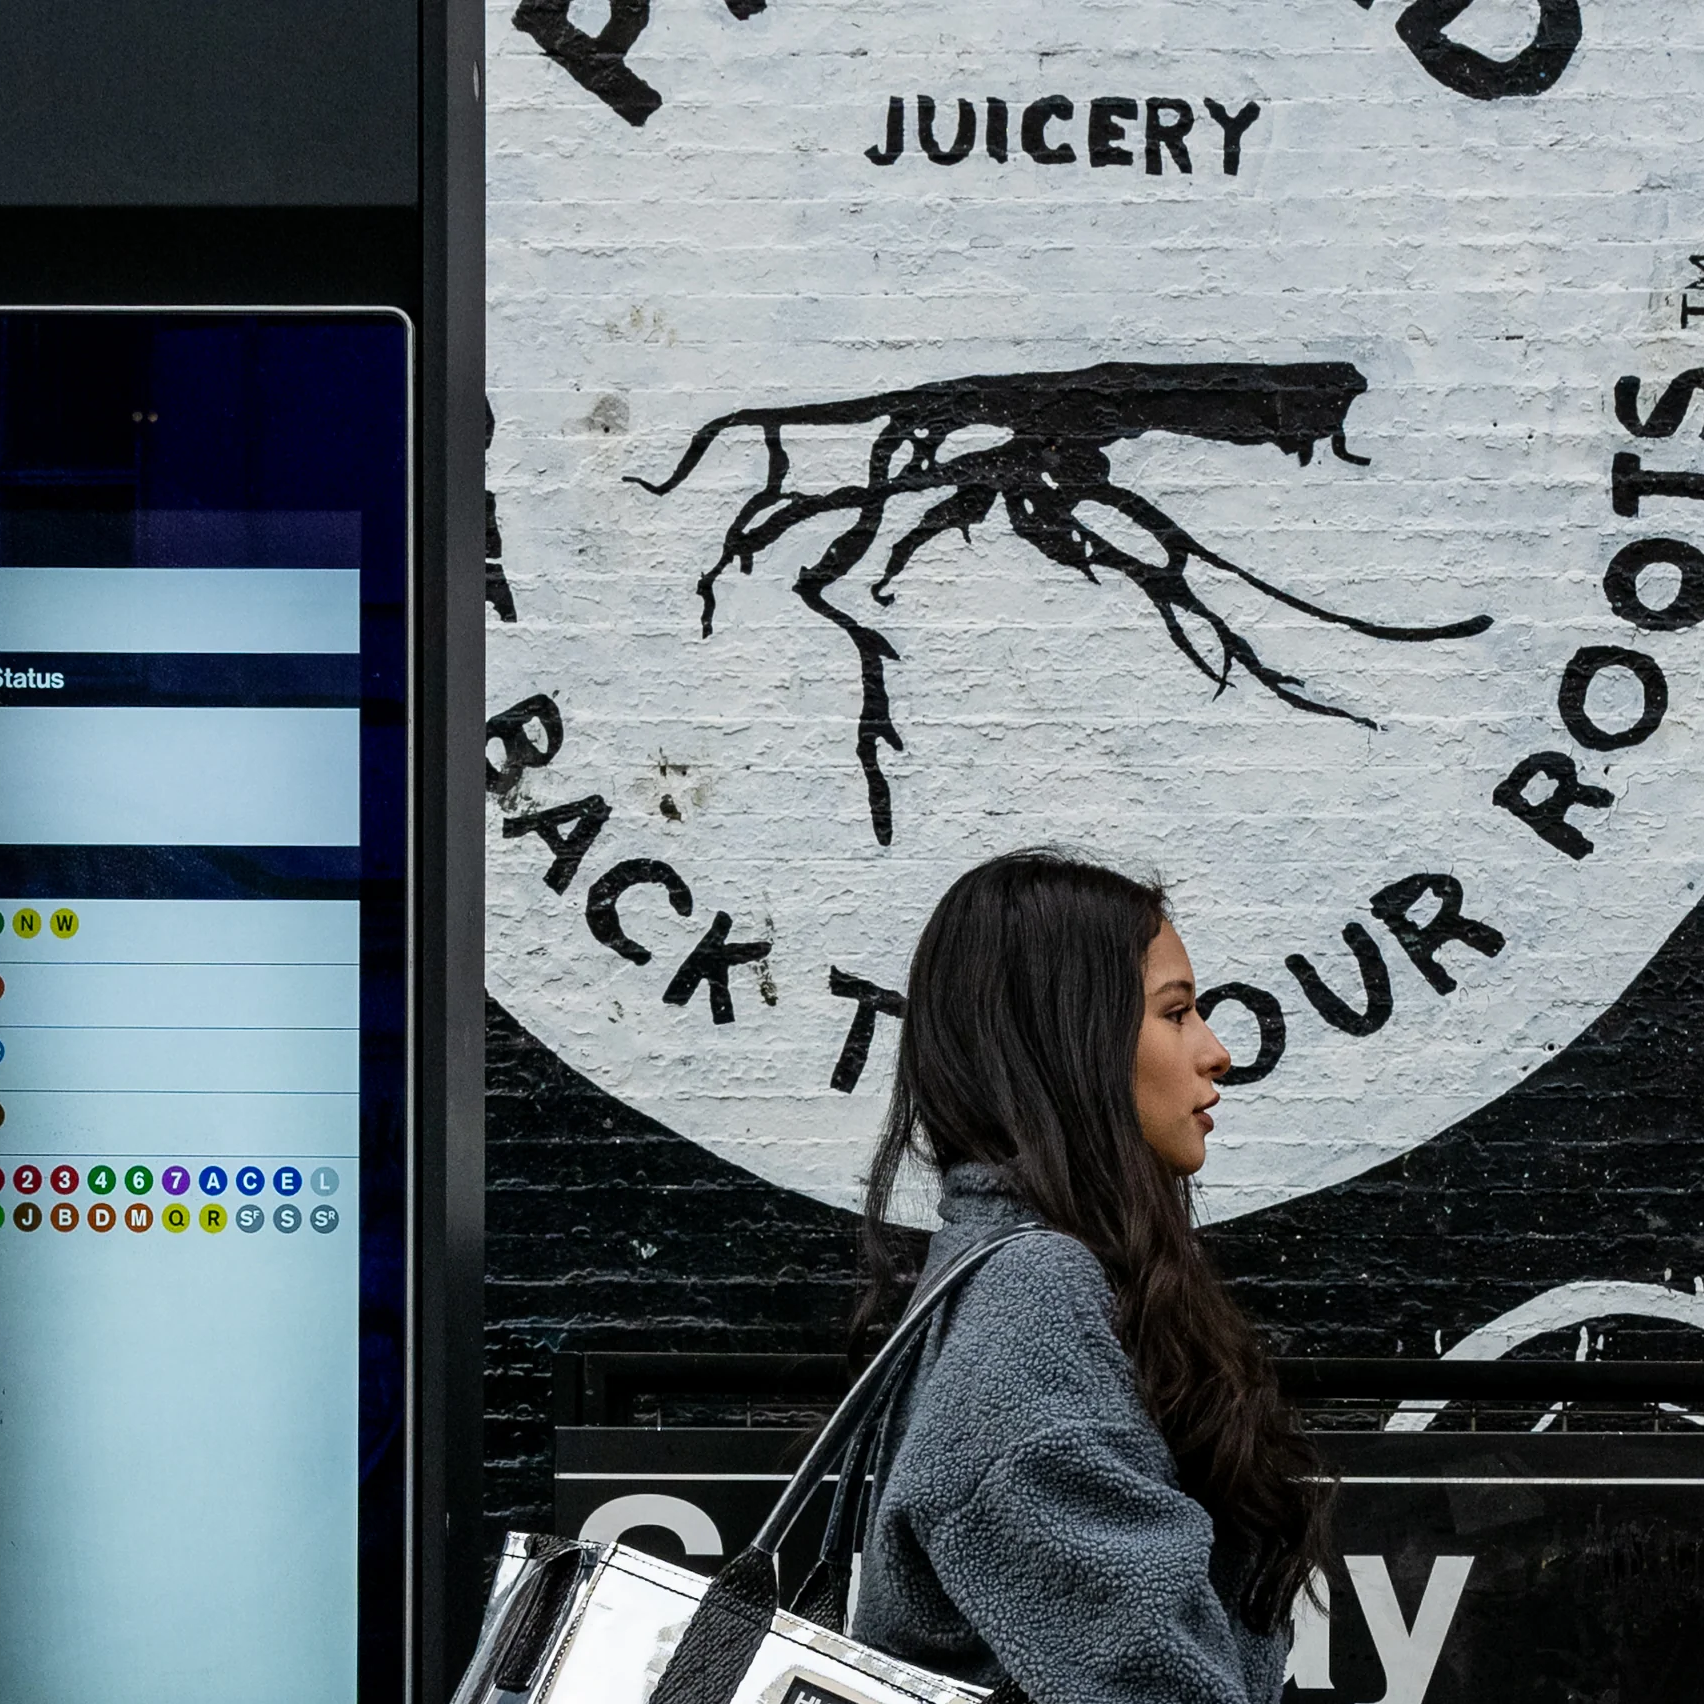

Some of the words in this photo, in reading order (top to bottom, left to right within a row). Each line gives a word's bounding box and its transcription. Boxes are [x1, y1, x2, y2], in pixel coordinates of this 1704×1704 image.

[863, 93, 1262, 177] JUICERY
[485, 693, 772, 1025] BACK
[1194, 872, 1507, 1087] OUR
[21, 915, 34, 931] N
[57, 915, 73, 931] W
[22, 1171, 34, 1187] 2
[59, 1171, 71, 1188] 3
[95, 1172, 108, 1188] 4
[133, 1172, 145, 1188] 6
[171, 1172, 182, 1188] 7
[206, 1173, 221, 1189] A
[243, 1173, 257, 1189] C
[282, 1173, 294, 1189] E
[319, 1173, 330, 1189] L
[22, 1209, 33, 1225] J
[59, 1209, 72, 1226] B
[96, 1209, 109, 1226] D
[131, 1210, 147, 1226] M
[169, 1210, 184, 1227] Q
[208, 1210, 220, 1226] R
[281, 1210, 294, 1227] S
